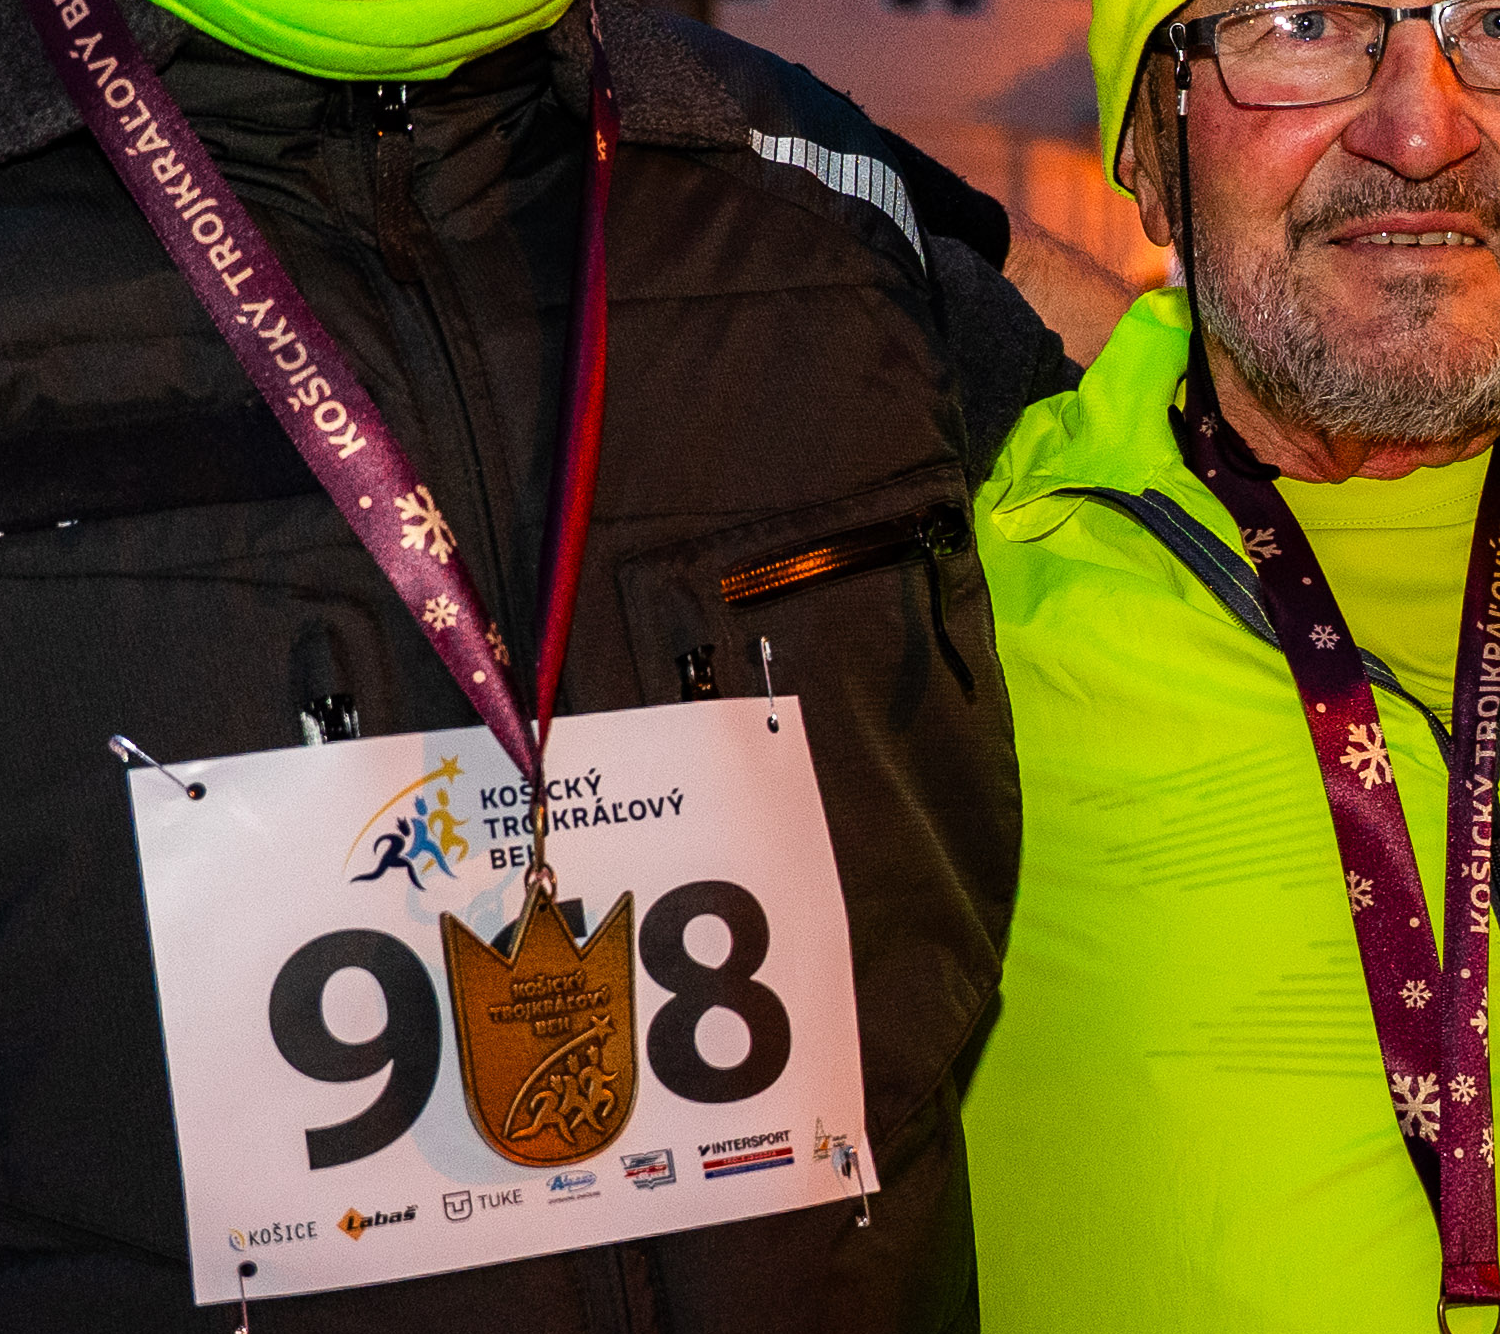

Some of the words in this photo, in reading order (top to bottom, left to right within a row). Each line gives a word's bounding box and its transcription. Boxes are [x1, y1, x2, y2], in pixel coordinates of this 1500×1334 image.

[70, 32, 254, 296] TROJKRÁĽOVÝ
[235, 298, 367, 460] KOŠICKÝ
[481, 768, 601, 810] KOŠCKÝ
[1461, 774, 1494, 934] KOŠICKÝ
[268, 880, 792, 1171] 98
[711, 1129, 792, 1154] INTERSPORT
[346, 1204, 419, 1232] Labaš
[478, 1188, 524, 1210] TUKE
[248, 1221, 318, 1247] KOŠICE
